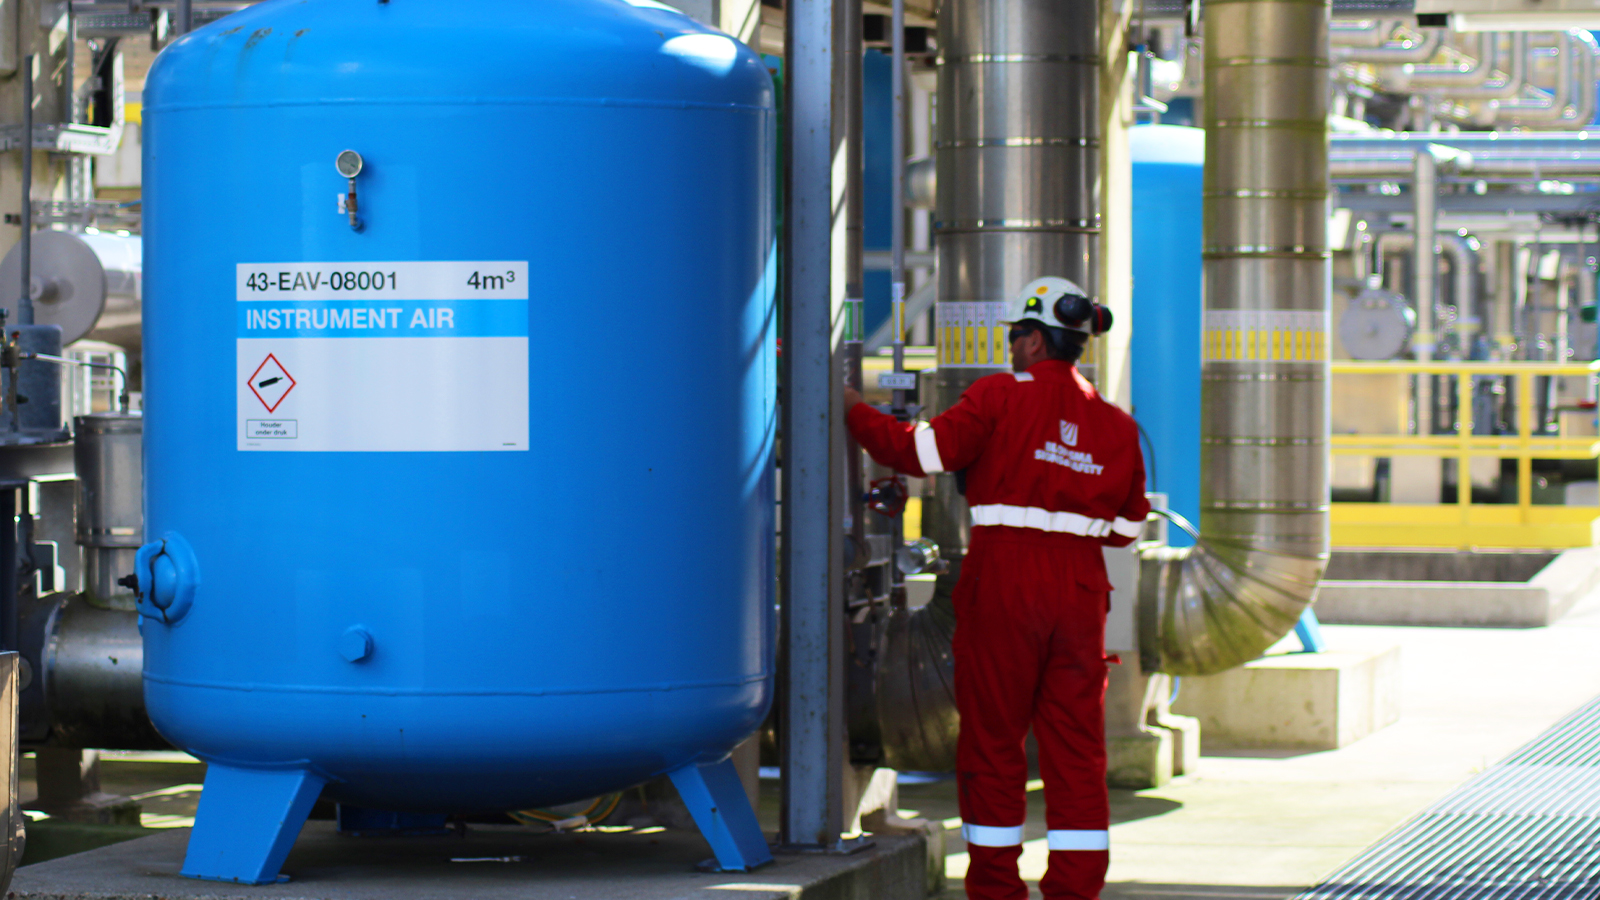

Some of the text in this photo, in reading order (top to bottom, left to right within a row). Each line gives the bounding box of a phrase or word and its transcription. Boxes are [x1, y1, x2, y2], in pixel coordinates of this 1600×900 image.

[246, 271, 397, 292] 43-EAV-08001
[246, 308, 455, 330] INSTRUMENT AIR
